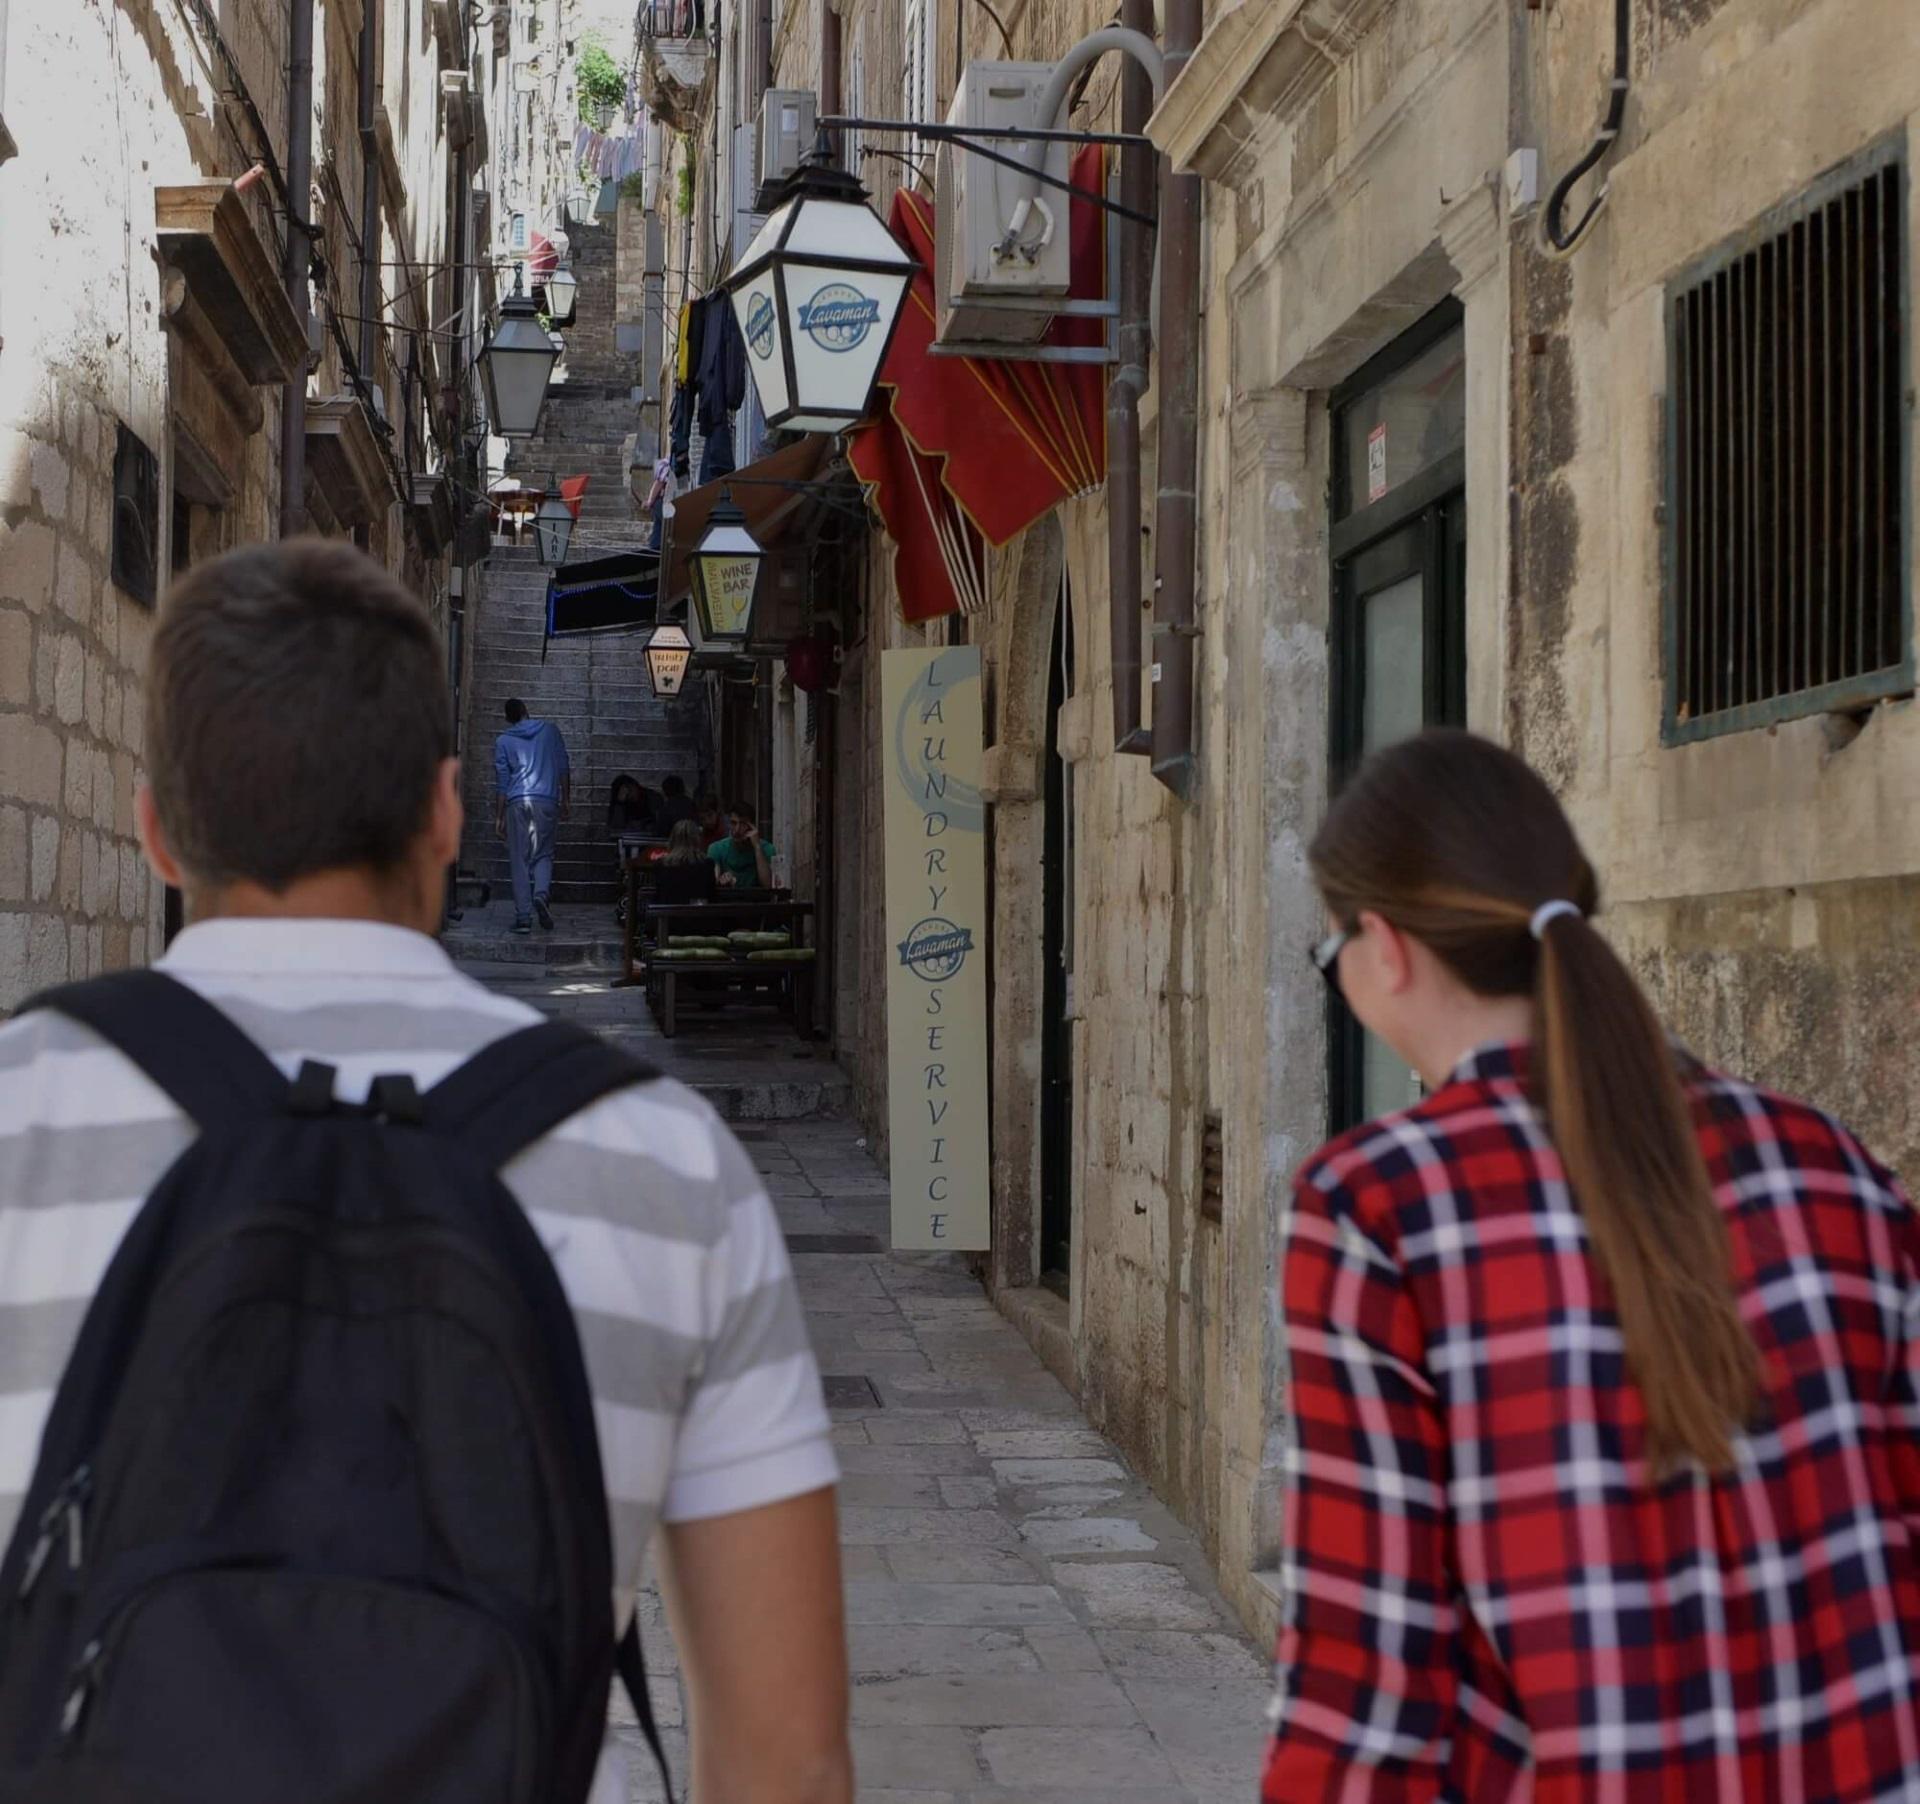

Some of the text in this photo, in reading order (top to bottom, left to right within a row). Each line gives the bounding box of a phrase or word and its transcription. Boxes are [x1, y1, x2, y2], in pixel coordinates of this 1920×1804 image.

[806, 303, 873, 325] Lavaman
[720, 563, 752, 579] WINE
[723, 578, 751, 594] BAR
[921, 661, 948, 911] LAUNDRY
[906, 935, 966, 961] Lavaman
[923, 988, 949, 1238] SERVICE
